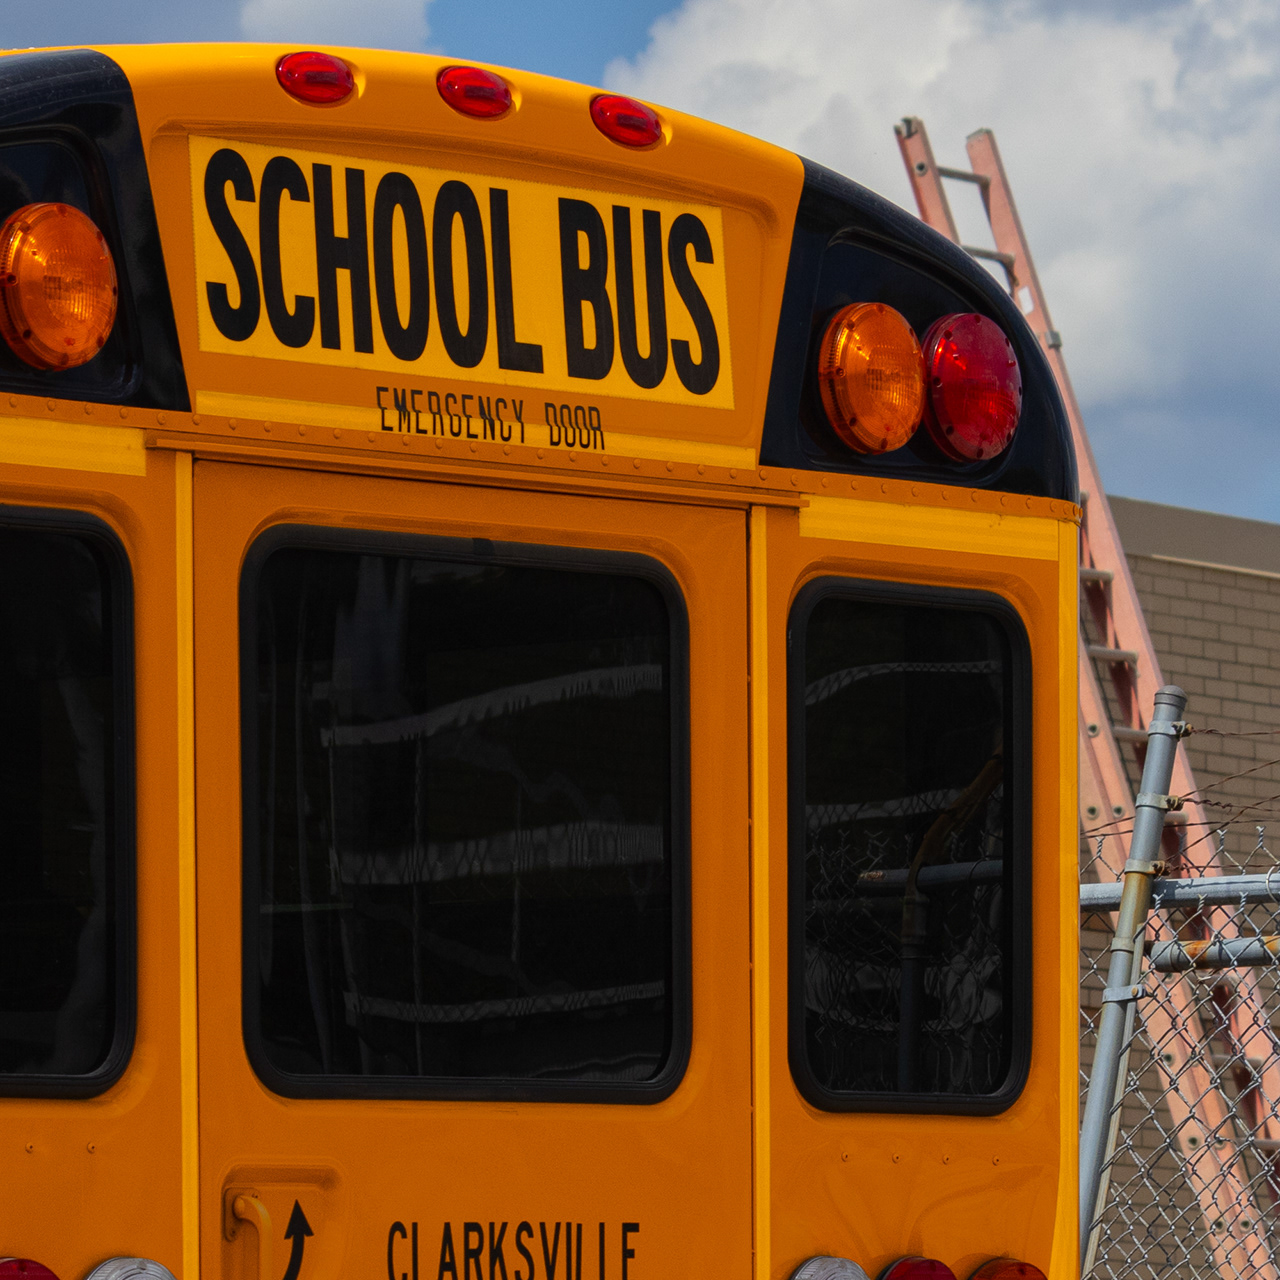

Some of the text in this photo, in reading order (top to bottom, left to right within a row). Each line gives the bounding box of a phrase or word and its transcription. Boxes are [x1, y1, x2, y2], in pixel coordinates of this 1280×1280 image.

[204, 148, 720, 396] SCHOOL BUS
[376, 386, 605, 450] EMERGENCY DOOR
